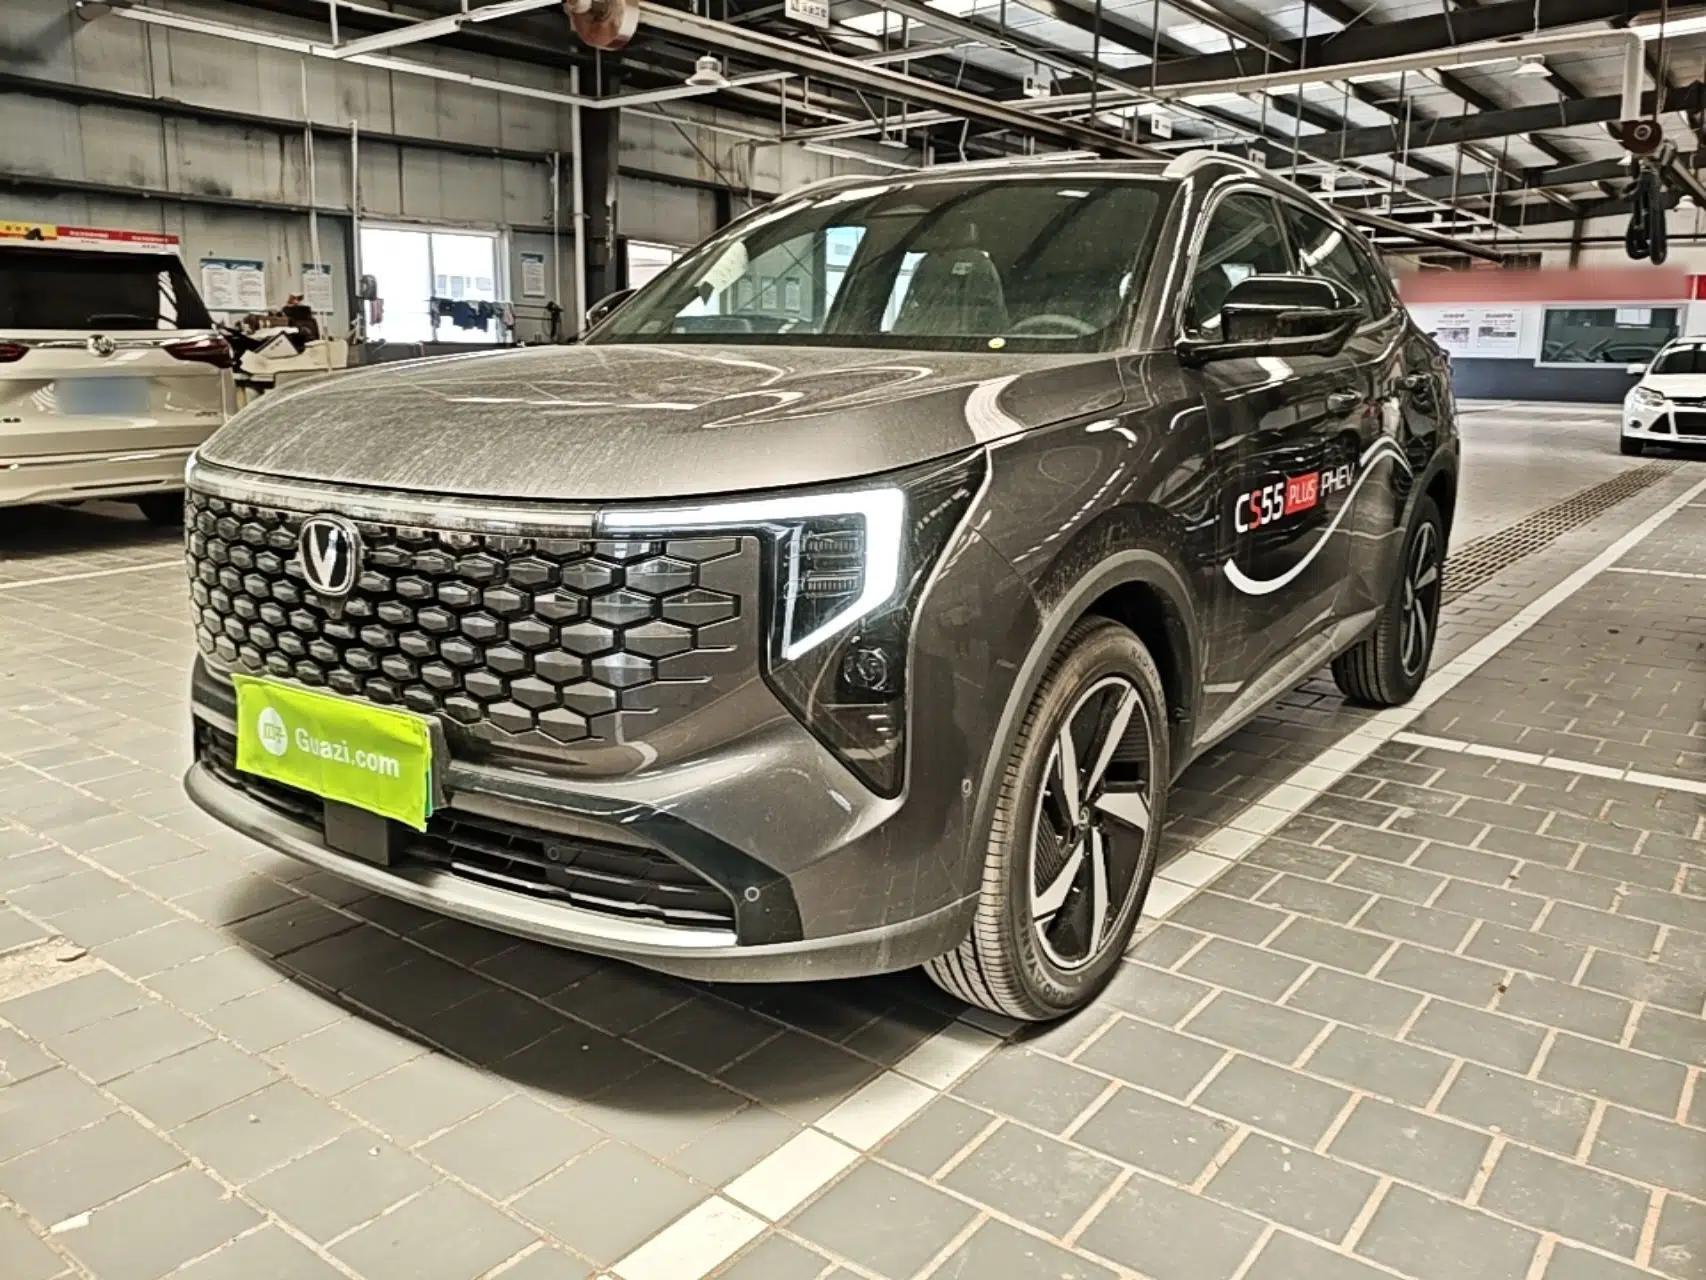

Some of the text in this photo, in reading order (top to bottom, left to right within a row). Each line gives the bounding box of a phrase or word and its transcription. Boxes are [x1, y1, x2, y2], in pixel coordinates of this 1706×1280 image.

[1235, 463, 1355, 533] CS55 PLUS PHEV
[295, 727, 400, 778] Guazi.com
